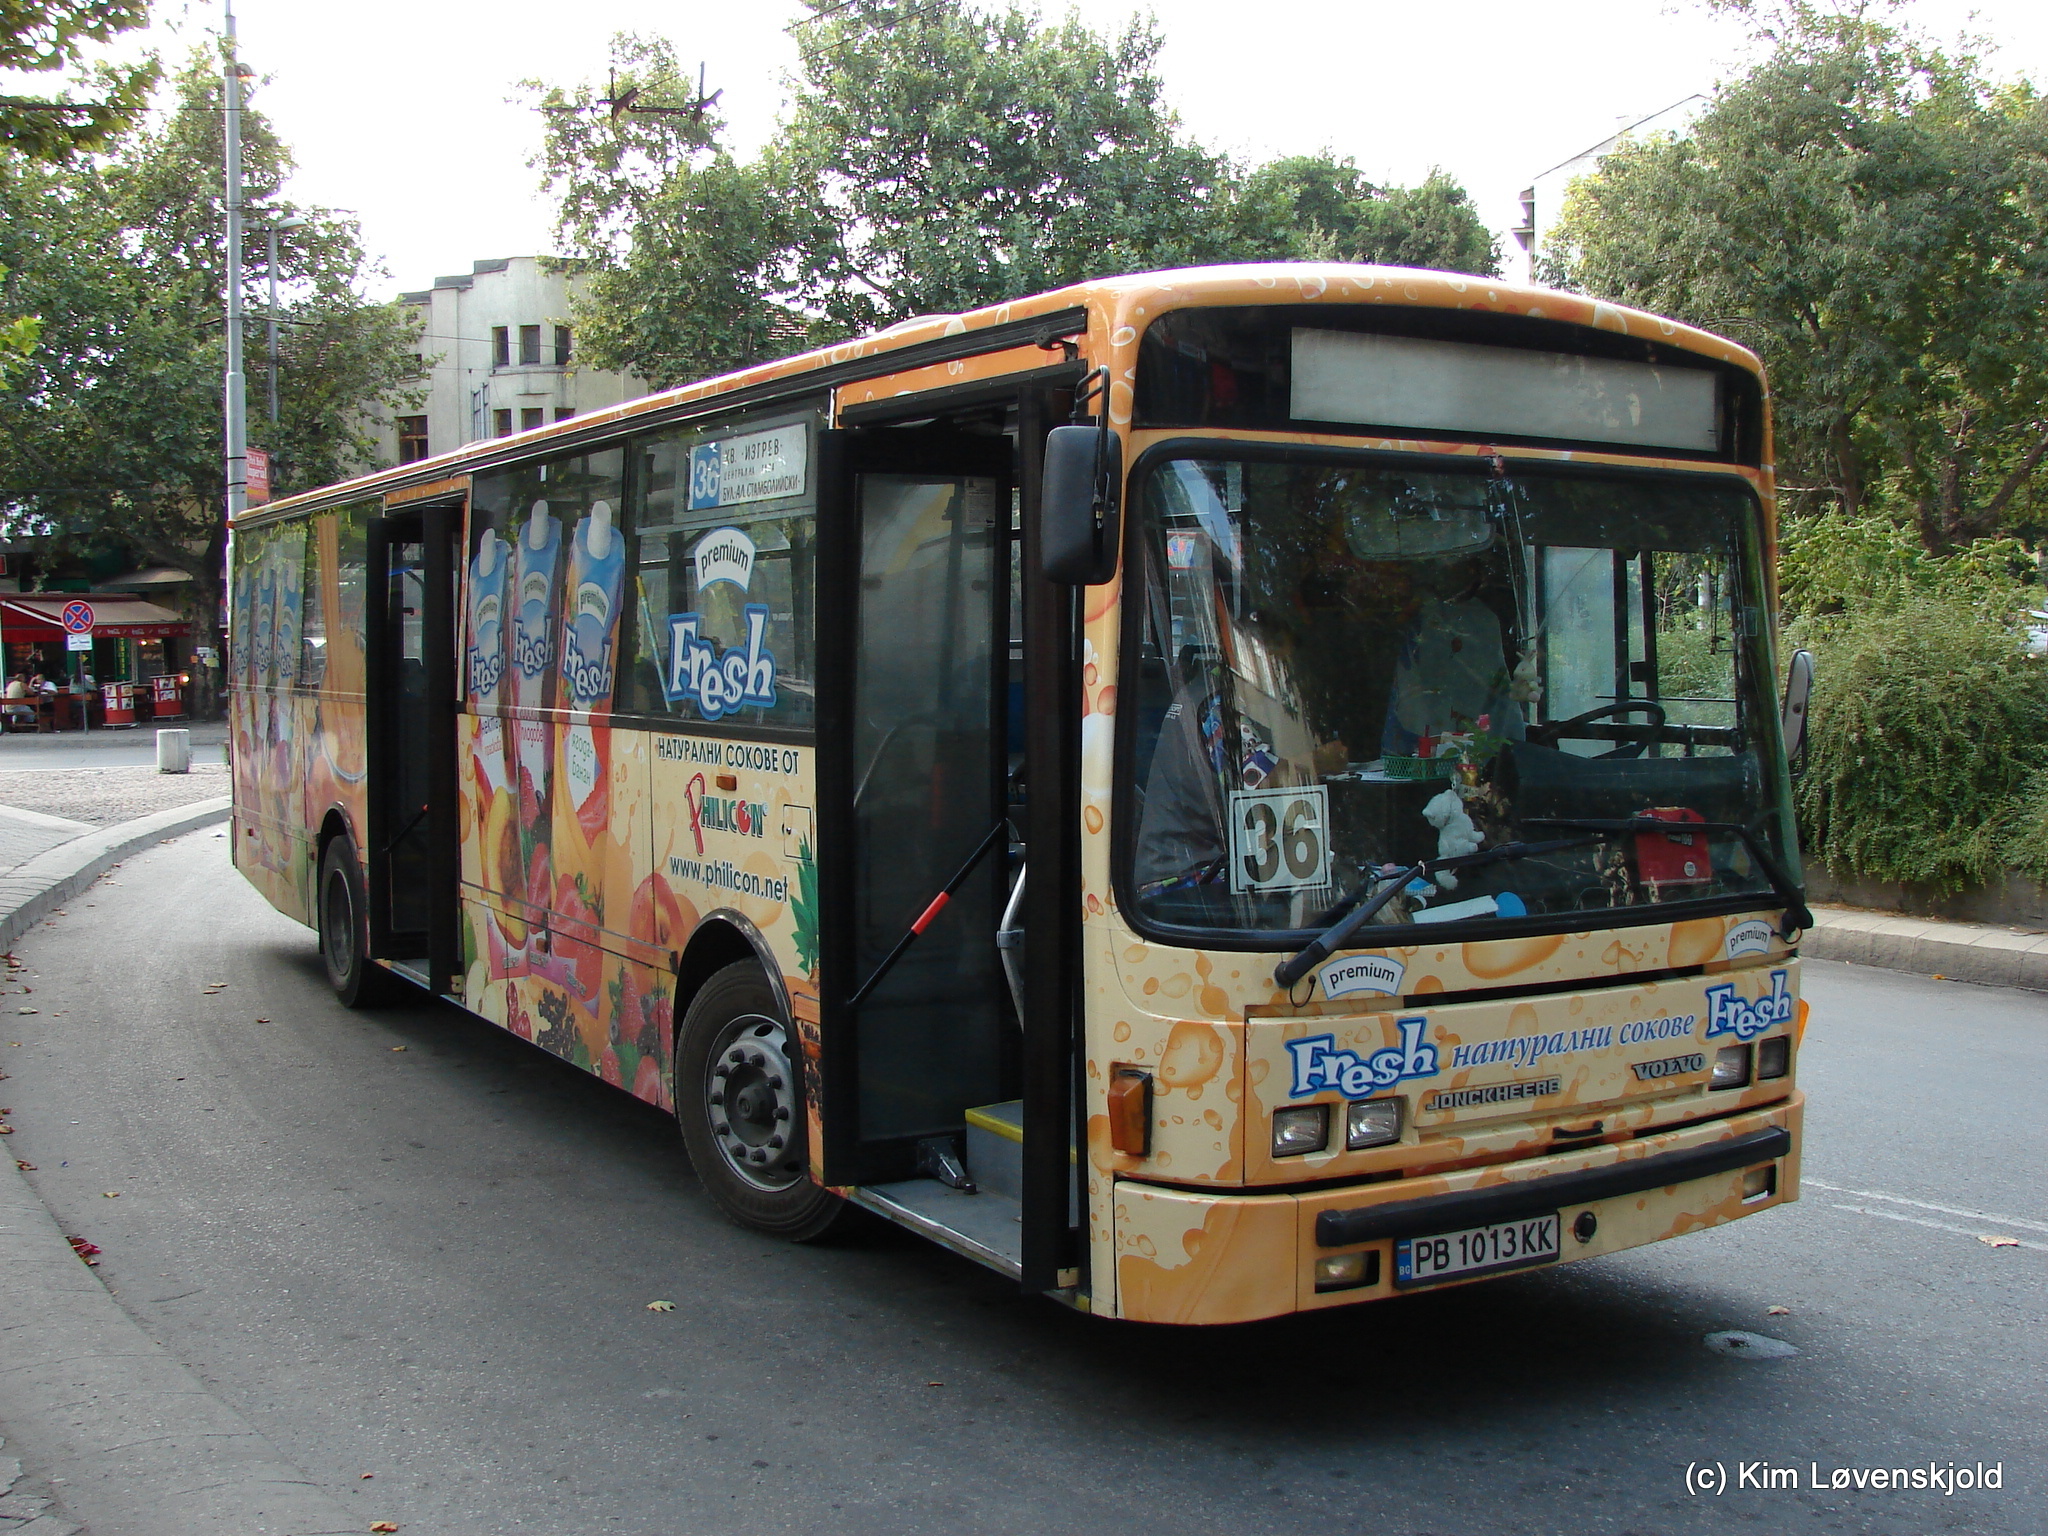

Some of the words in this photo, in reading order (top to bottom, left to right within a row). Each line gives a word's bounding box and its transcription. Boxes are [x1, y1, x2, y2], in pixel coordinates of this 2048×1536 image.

[695, 457, 720, 500] 36
[701, 539, 749, 577] premium
[580, 590, 607, 619] premium
[469, 631, 506, 695] Fresh
[514, 616, 553, 676] Fresh
[563, 623, 613, 699] Fresh
[669, 605, 776, 719] Fresh
[658, 737, 722, 766] НАТУРАЛНИ
[726, 744, 778, 772] СОКОВЕ
[782, 749, 799, 776] ОТ
[1243, 799, 1321, 883] 36
[670, 856, 788, 903] www.philicon.net
[1730, 926, 1768, 951] premium
[1329, 962, 1396, 989] premium
[1705, 970, 1792, 1040] Fresh
[1285, 1017, 1440, 1099] Fresh
[1452, 1025, 1612, 1068] натурални
[1618, 1014, 1696, 1046] сокове
[1632, 1053, 1706, 1081] VOLVO
[1425, 1077, 1561, 1111] JONCKHEERE
[1399, 1264, 1411, 1276] BG
[1415, 1238, 1450, 1274] PB
[1458, 1226, 1517, 1266] 1013
[1521, 1219, 1553, 1255] KK
